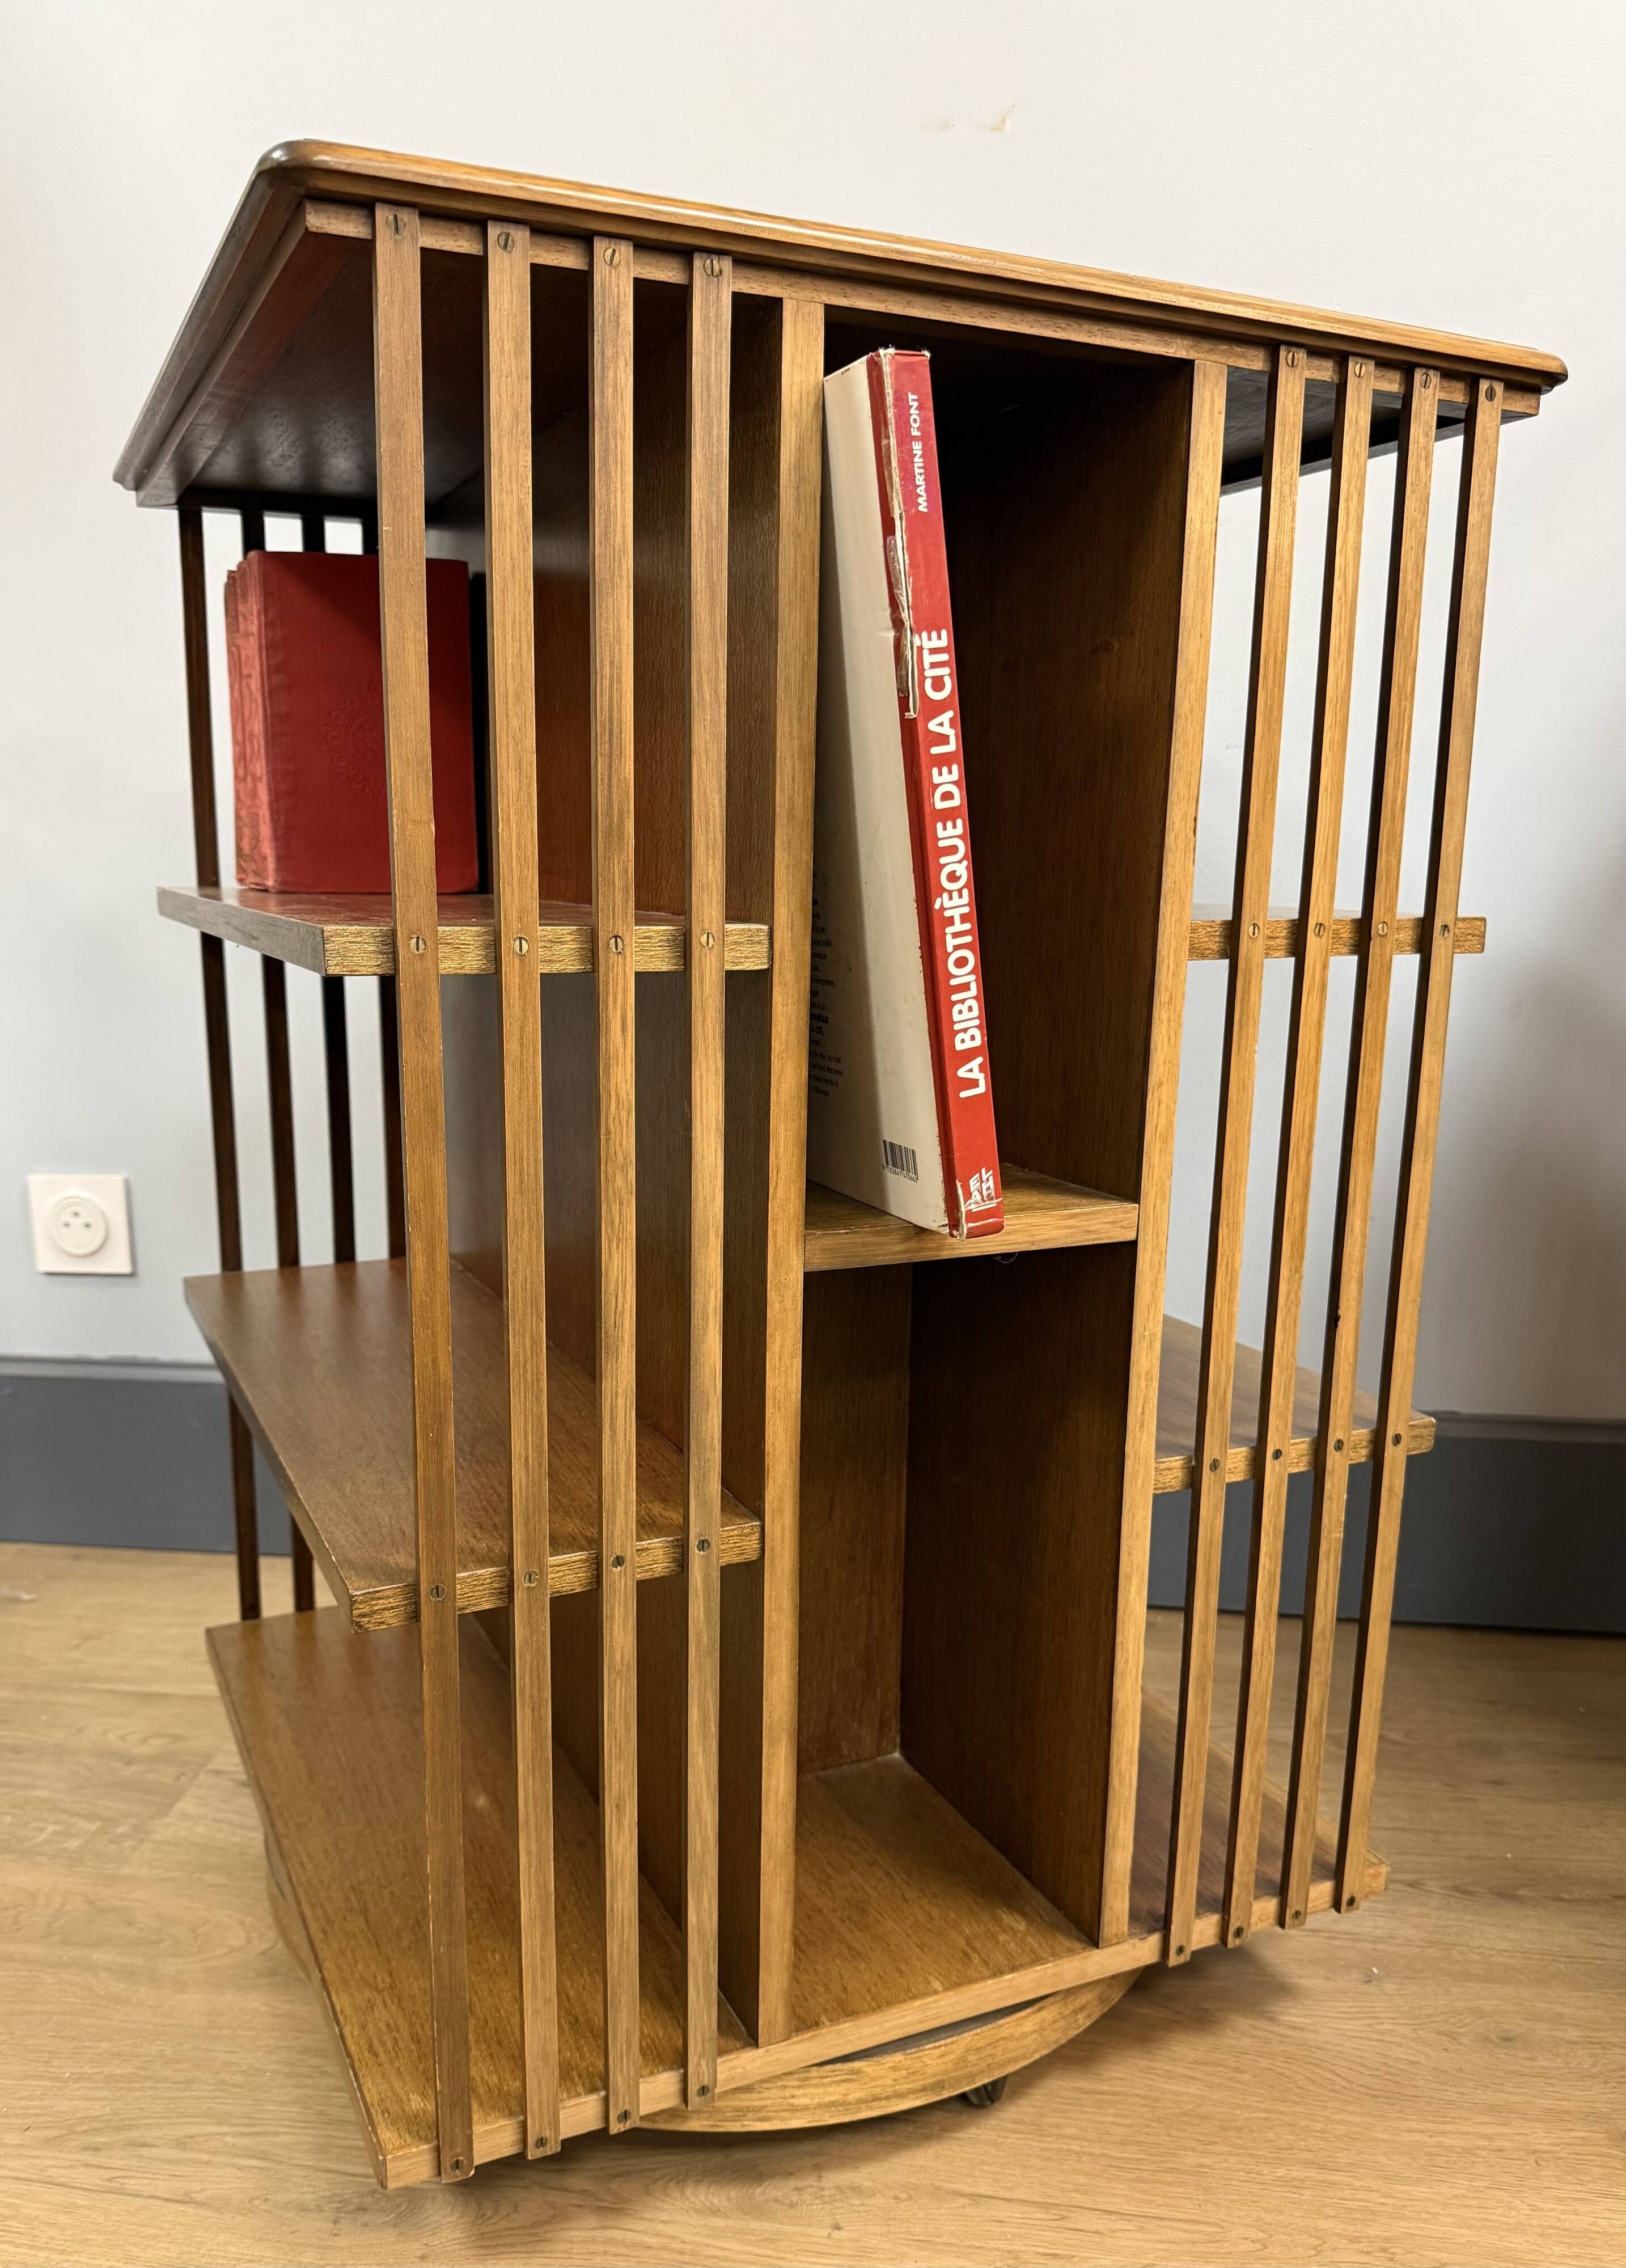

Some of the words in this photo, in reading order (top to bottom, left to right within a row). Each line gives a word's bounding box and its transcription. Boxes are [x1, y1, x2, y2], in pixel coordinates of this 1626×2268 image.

[908, 391, 921, 436] FONT
[912, 439, 929, 513] MARTINE
[915, 628, 953, 701] CITÉ
[928, 709, 957, 755] LA
[931, 763, 962, 810] DE
[934, 818, 982, 1051] BIBLIOTHÈQUE
[956, 1056, 986, 1098] LA
